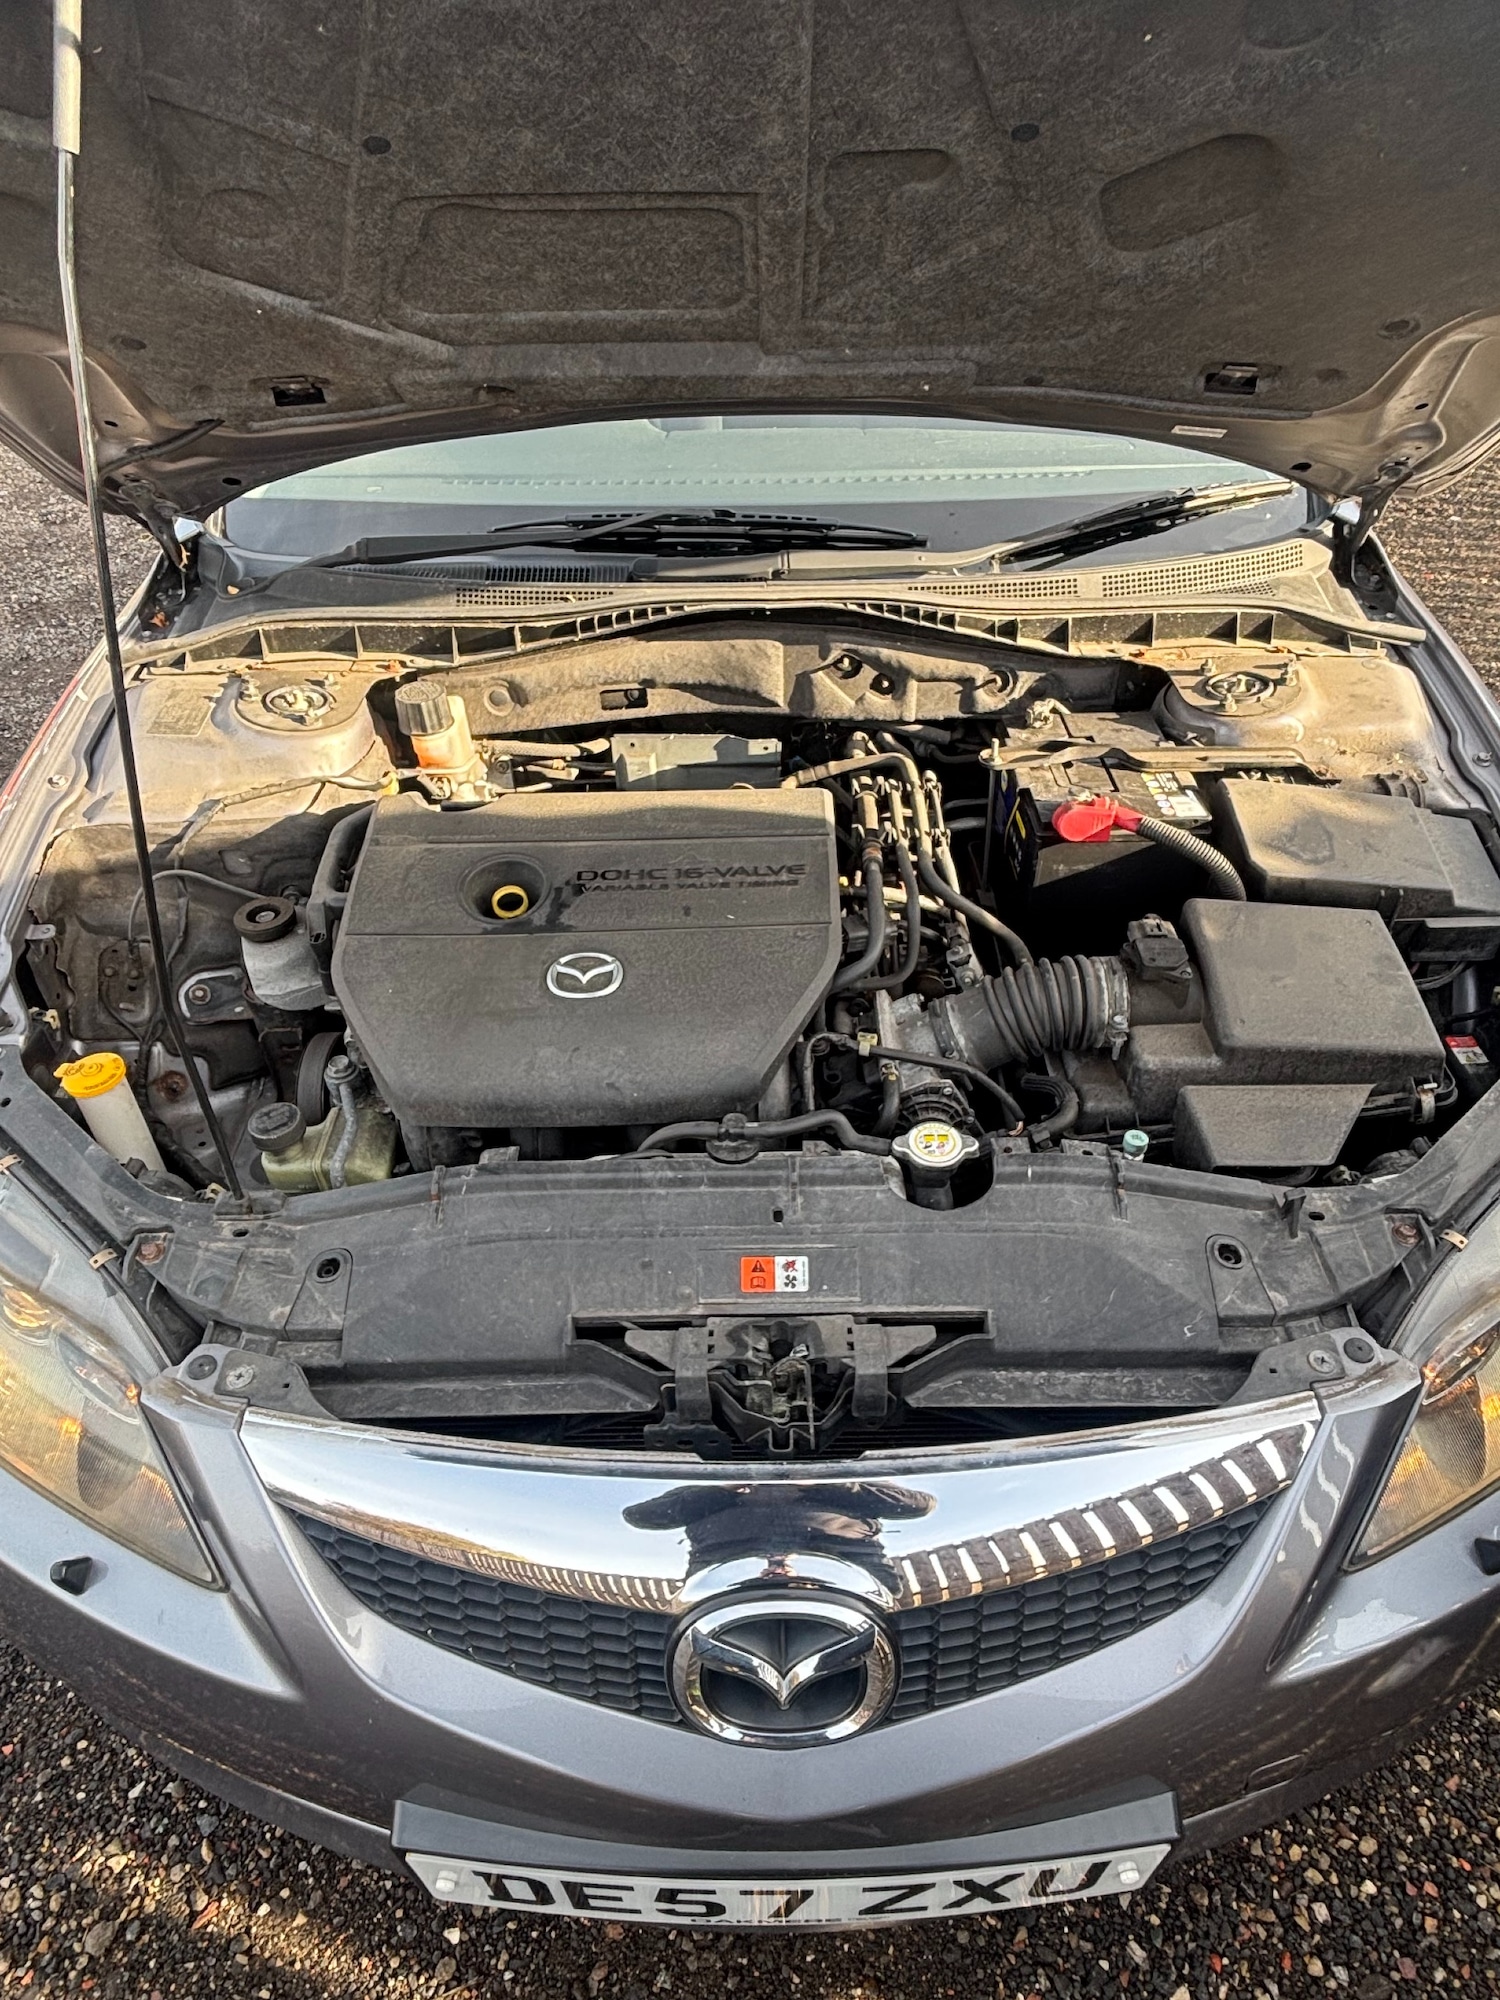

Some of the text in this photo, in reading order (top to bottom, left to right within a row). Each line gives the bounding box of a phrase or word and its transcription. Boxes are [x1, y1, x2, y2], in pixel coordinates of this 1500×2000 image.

[576, 864, 806, 881] DOHC 16-VALVE
[579, 880, 799, 892] VARIABLE VALVE TIMING
[471, 1860, 1112, 1918] DE57 ZXU
